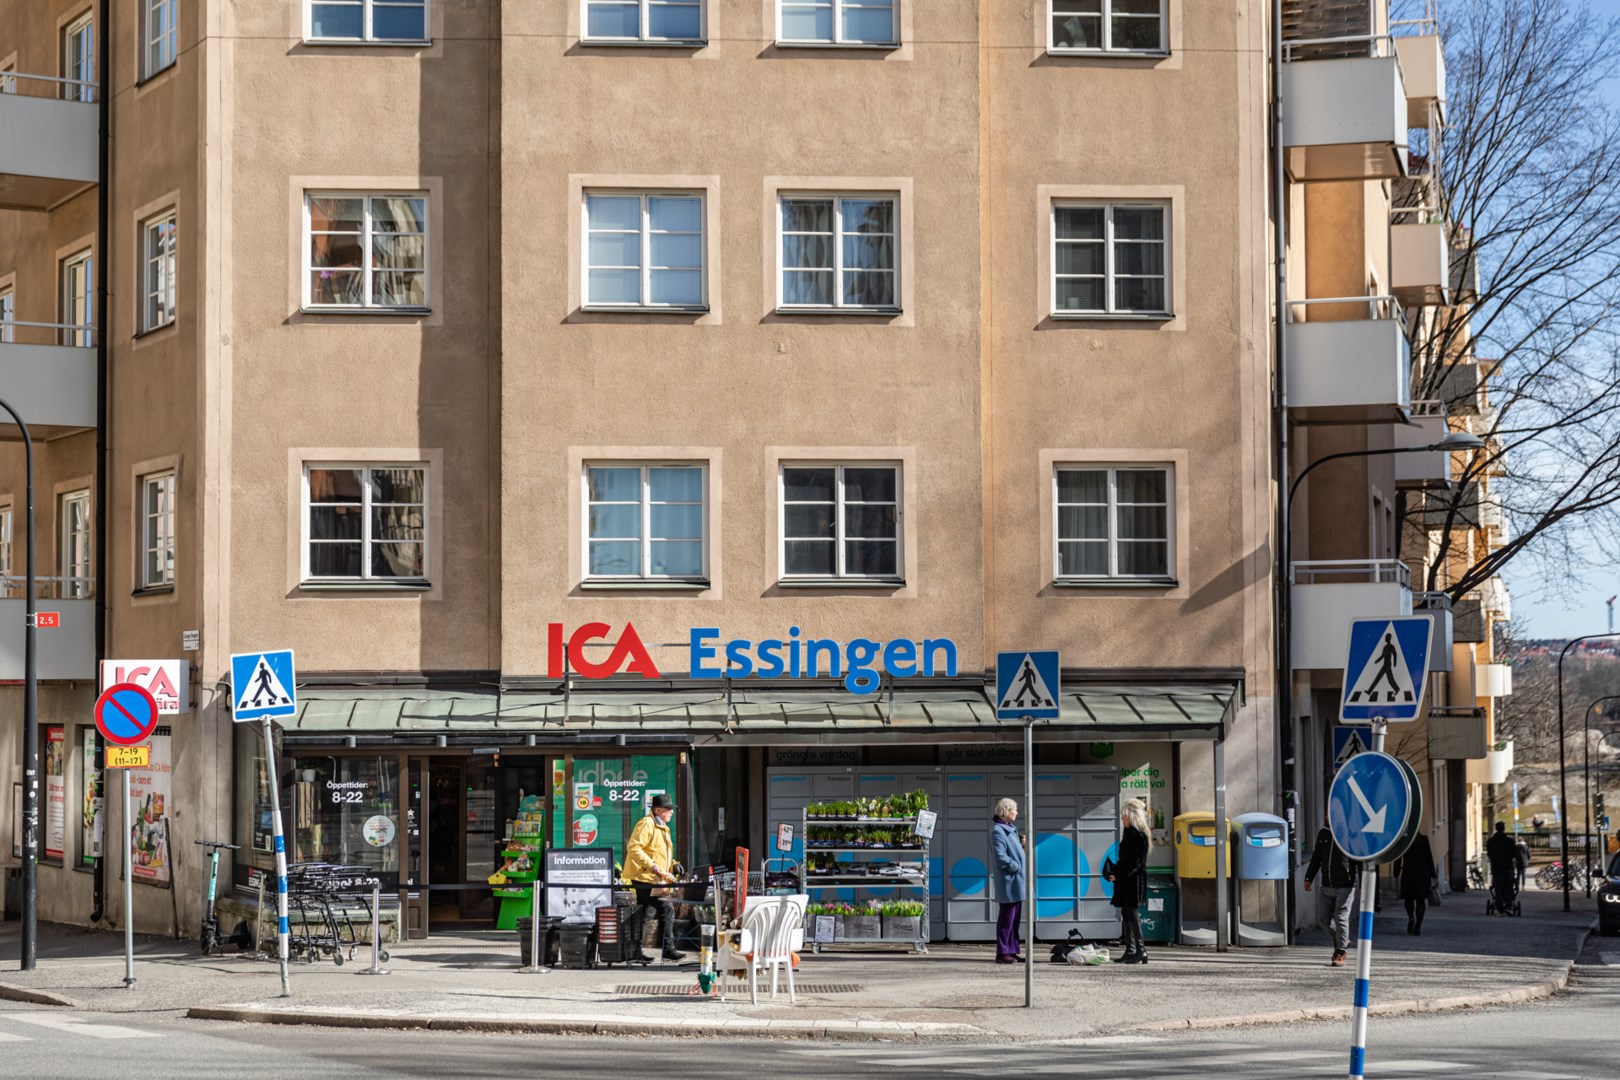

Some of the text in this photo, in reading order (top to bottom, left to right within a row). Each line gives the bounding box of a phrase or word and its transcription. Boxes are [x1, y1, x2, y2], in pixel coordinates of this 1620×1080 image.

[39, 616, 54, 625] 2,5
[547, 622, 958, 695] ICA Essingen
[115, 666, 178, 697] ICA
[115, 757, 142, 765] (11-17)
[1120, 767, 1141, 778] lper
[1143, 767, 1159, 778] dig
[326, 780, 369, 790] Öppettider:
[603, 778, 645, 788] Öppettider:
[1130, 779, 1147, 788] rätt
[1150, 779, 1165, 788] val
[332, 791, 363, 803] 8-22
[609, 790, 640, 801] 8-22
[553, 855, 606, 865] Information
